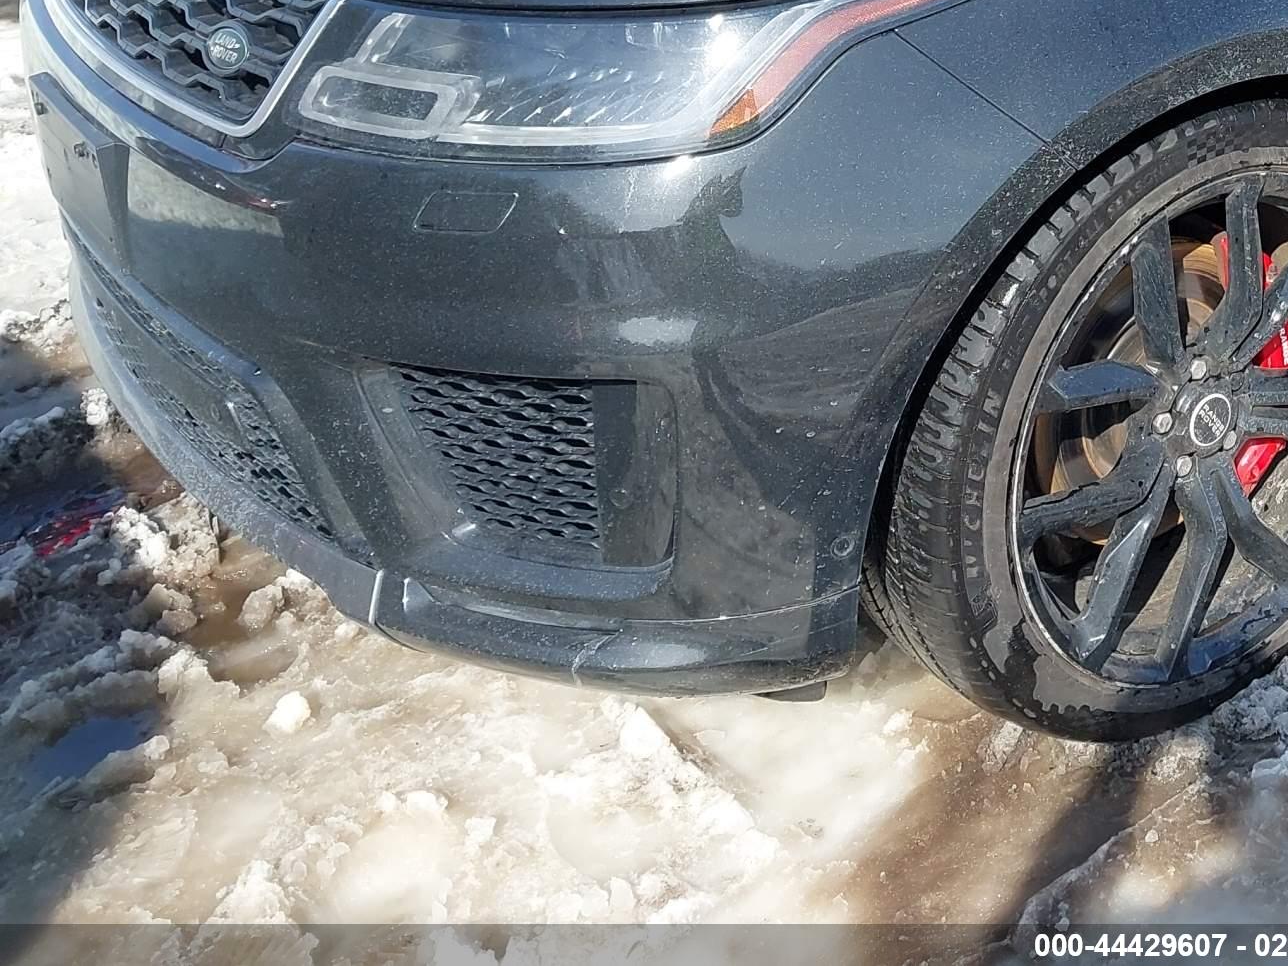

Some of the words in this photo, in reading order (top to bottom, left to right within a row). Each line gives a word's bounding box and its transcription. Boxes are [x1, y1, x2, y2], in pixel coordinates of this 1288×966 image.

[215, 33, 236, 49] LAND
[212, 45, 238, 64] ROVER
[1199, 409, 1221, 437] ROVER
[1203, 404, 1225, 431] RANGE
